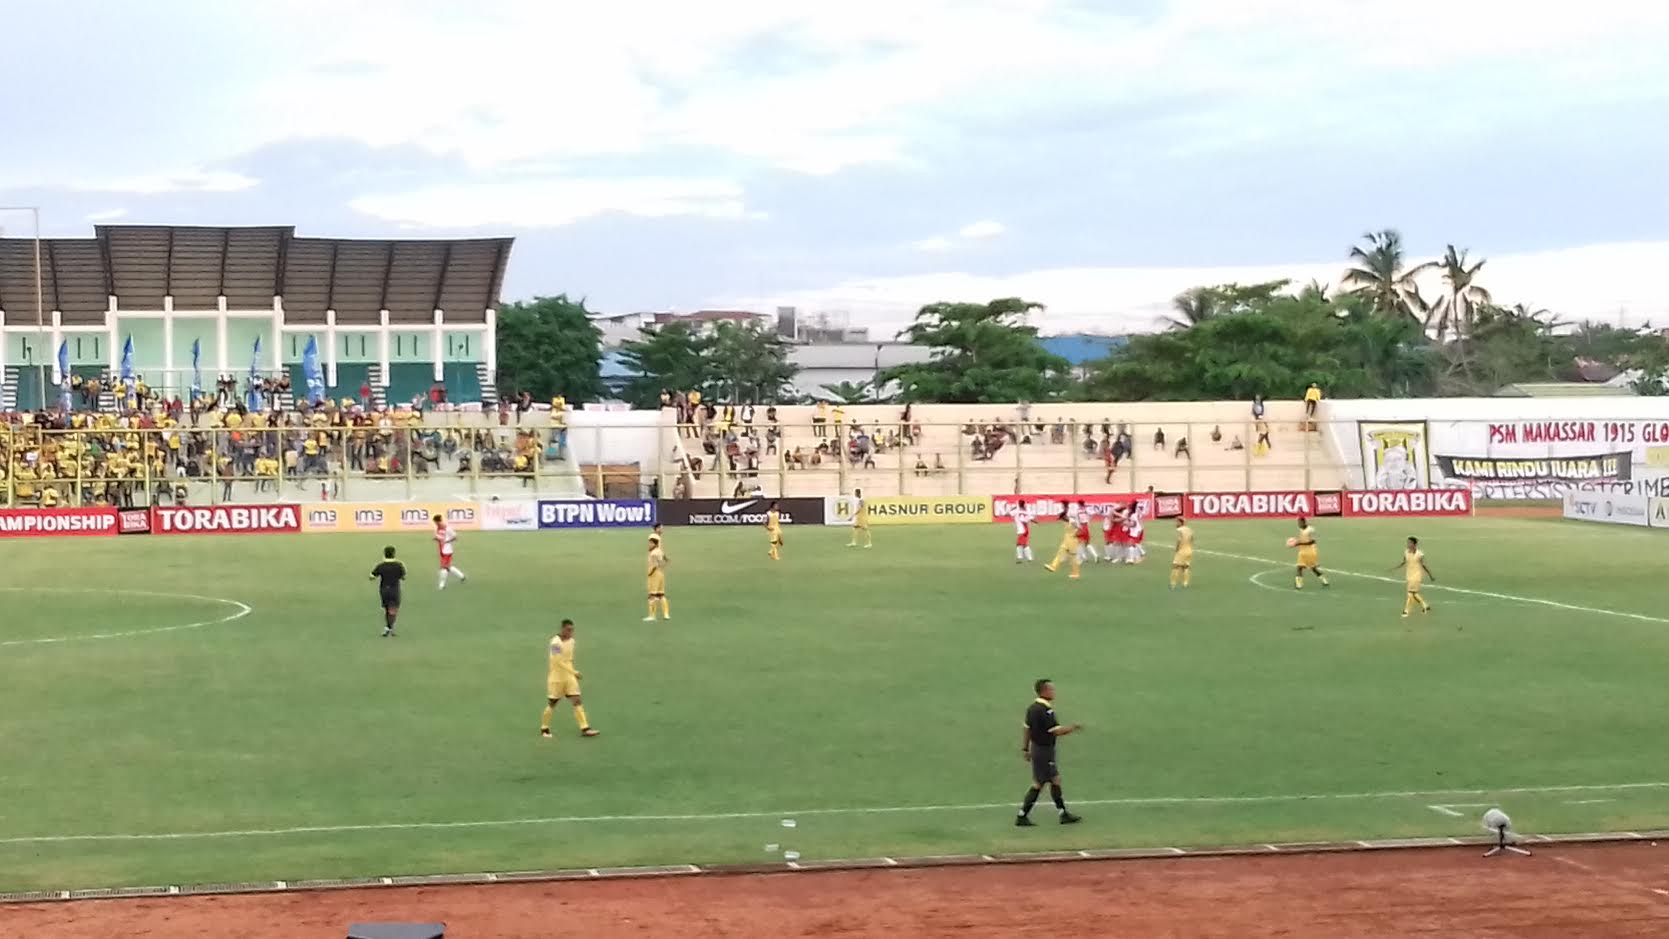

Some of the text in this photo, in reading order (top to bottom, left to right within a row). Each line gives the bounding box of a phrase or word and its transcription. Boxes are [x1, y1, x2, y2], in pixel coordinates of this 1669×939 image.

[1489, 423, 1517, 444] PSM
[1522, 421, 1596, 443] MAKASSAR
[1603, 421, 1635, 443] 1915
[1451, 459, 1495, 478] KAMI
[1497, 459, 1549, 478] RINDU
[867, 502, 987, 516] HASNUR GROUP
[1188, 493, 1309, 514] TORABIKA
[1347, 491, 1467, 512] TORABIKA
[157, 507, 298, 531] TORABIKA
[541, 503, 595, 524] BTPN
[597, 502, 652, 523] Wow!
